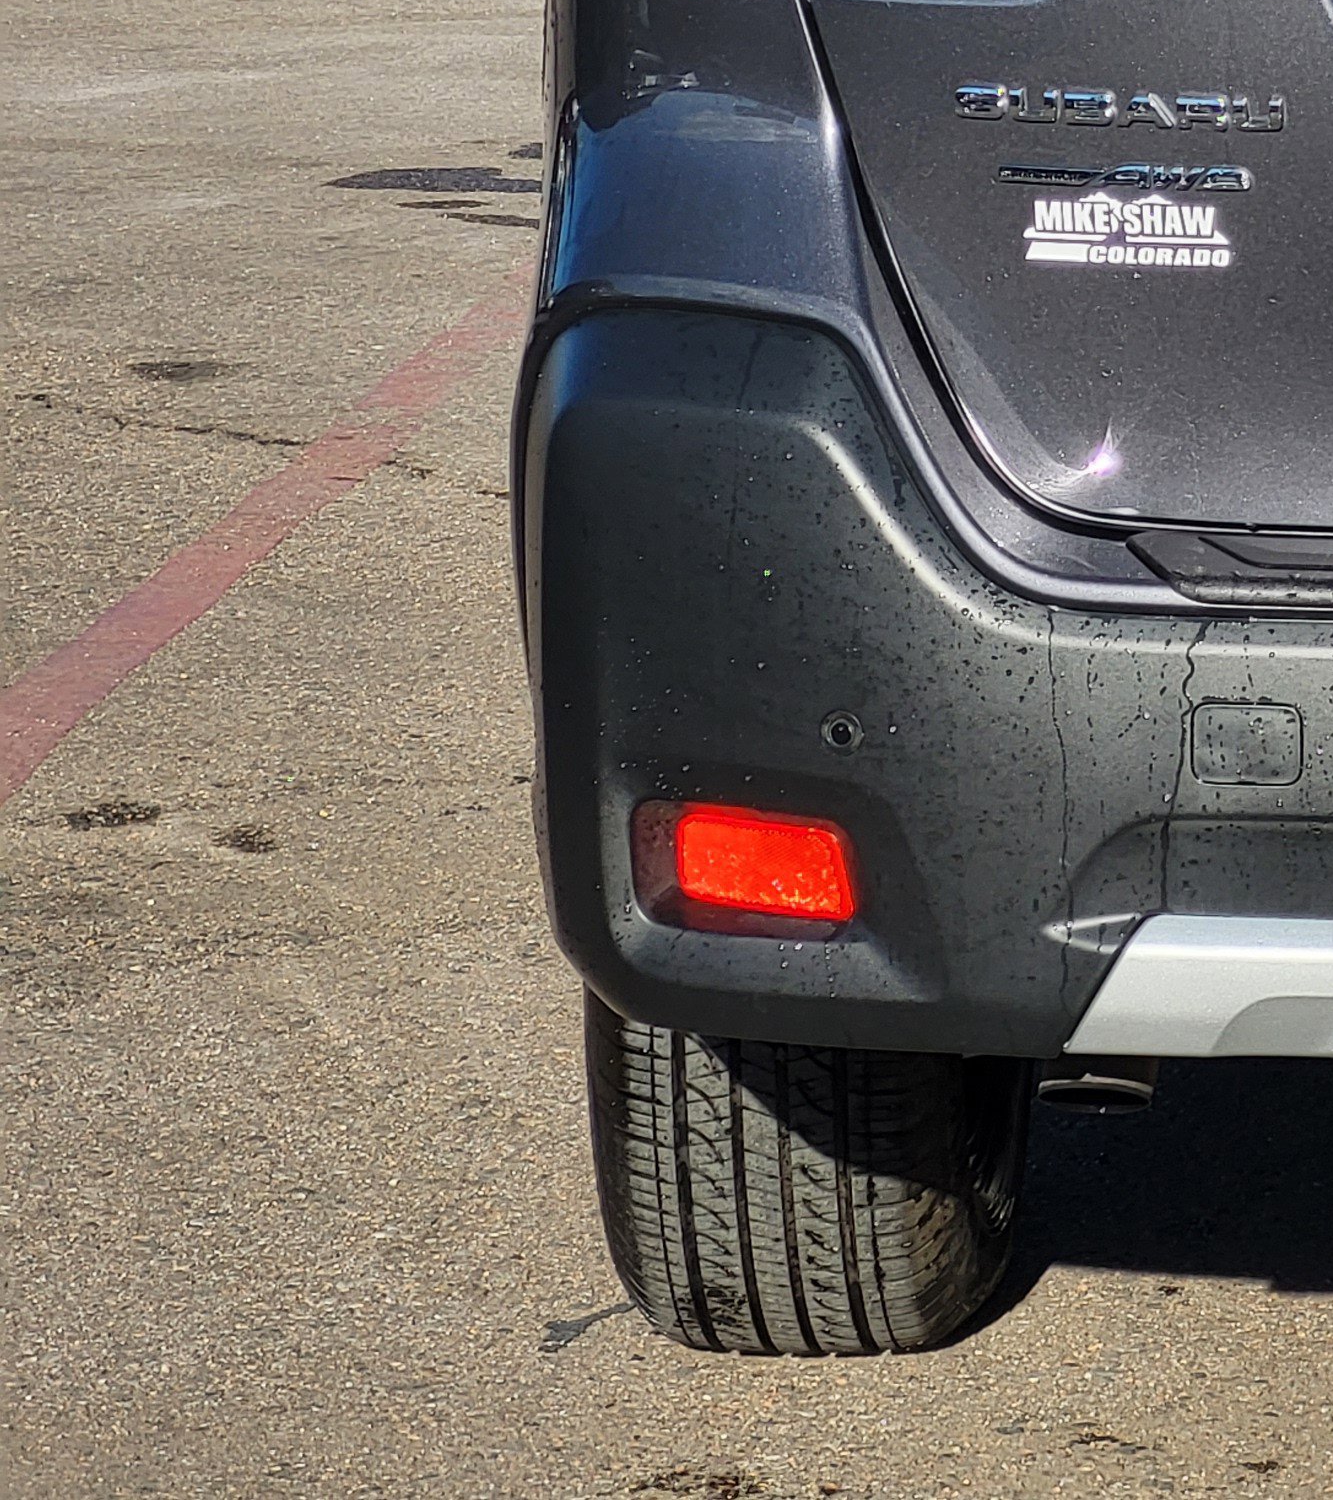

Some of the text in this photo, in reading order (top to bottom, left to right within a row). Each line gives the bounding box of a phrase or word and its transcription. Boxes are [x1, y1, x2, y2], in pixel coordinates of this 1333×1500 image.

[953, 82, 1288, 132] SUBARU
[1033, 200, 1216, 238] MIKE SHAW
[1089, 244, 1231, 268] COLORADO
